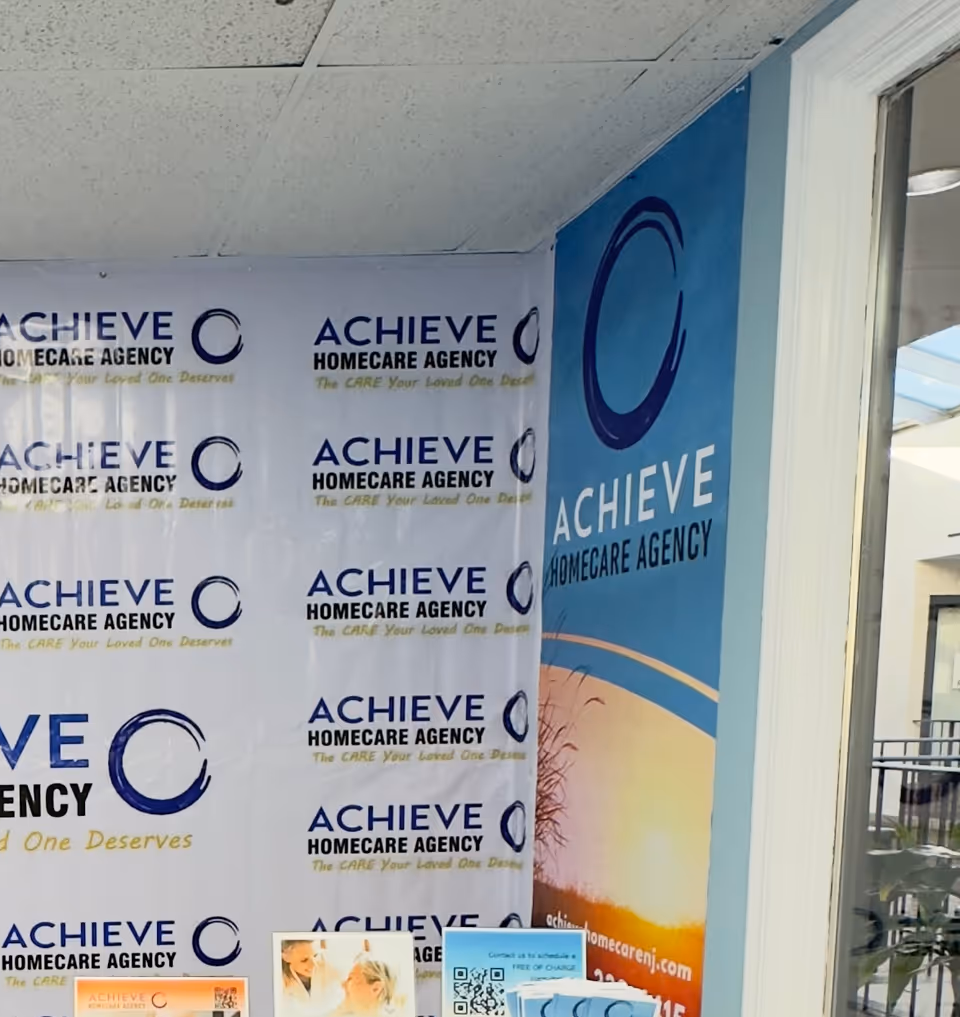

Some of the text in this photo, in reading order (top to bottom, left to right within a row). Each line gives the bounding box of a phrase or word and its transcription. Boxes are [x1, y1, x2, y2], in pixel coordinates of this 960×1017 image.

[314, 315, 497, 345] ACHIEVE
[101, 347, 174, 365] AGENCY
[314, 350, 497, 370] HOMECARE AGENCY
[312, 436, 493, 466] ACHIEVE
[105, 475, 176, 493] AGENCY
[313, 470, 494, 490] HOMECARE AGENCY
[553, 444, 715, 544] ACHIEVE
[550, 519, 712, 587] HOMECARE AGENCY
[307, 567, 486, 596] ACHIEVE
[307, 601, 486, 620] HOMECARE AGENCY
[104, 612, 175, 630] AGENCY
[313, 625, 486, 637] The CARE Your Loved One
[0, 636, 232, 651] The CARE Your Loved One Deserves
[308, 695, 484, 723] ACHIEVE
[308, 727, 485, 746] HOMECARE AGENCY
[308, 803, 482, 832] ACHIEVE
[23, 831, 70, 852] One
[85, 830, 191, 851] Deserves
[308, 836, 483, 854] HOMECARE AGENCY
[2, 920, 175, 948] ACHIEVE
[546, 910, 692, 982] achihomecarenj.com
[2, 952, 176, 970] HOMECARE AGENCY
[5, 976, 67, 987] The CARE
[88, 993, 146, 1002] ACHIEVE
